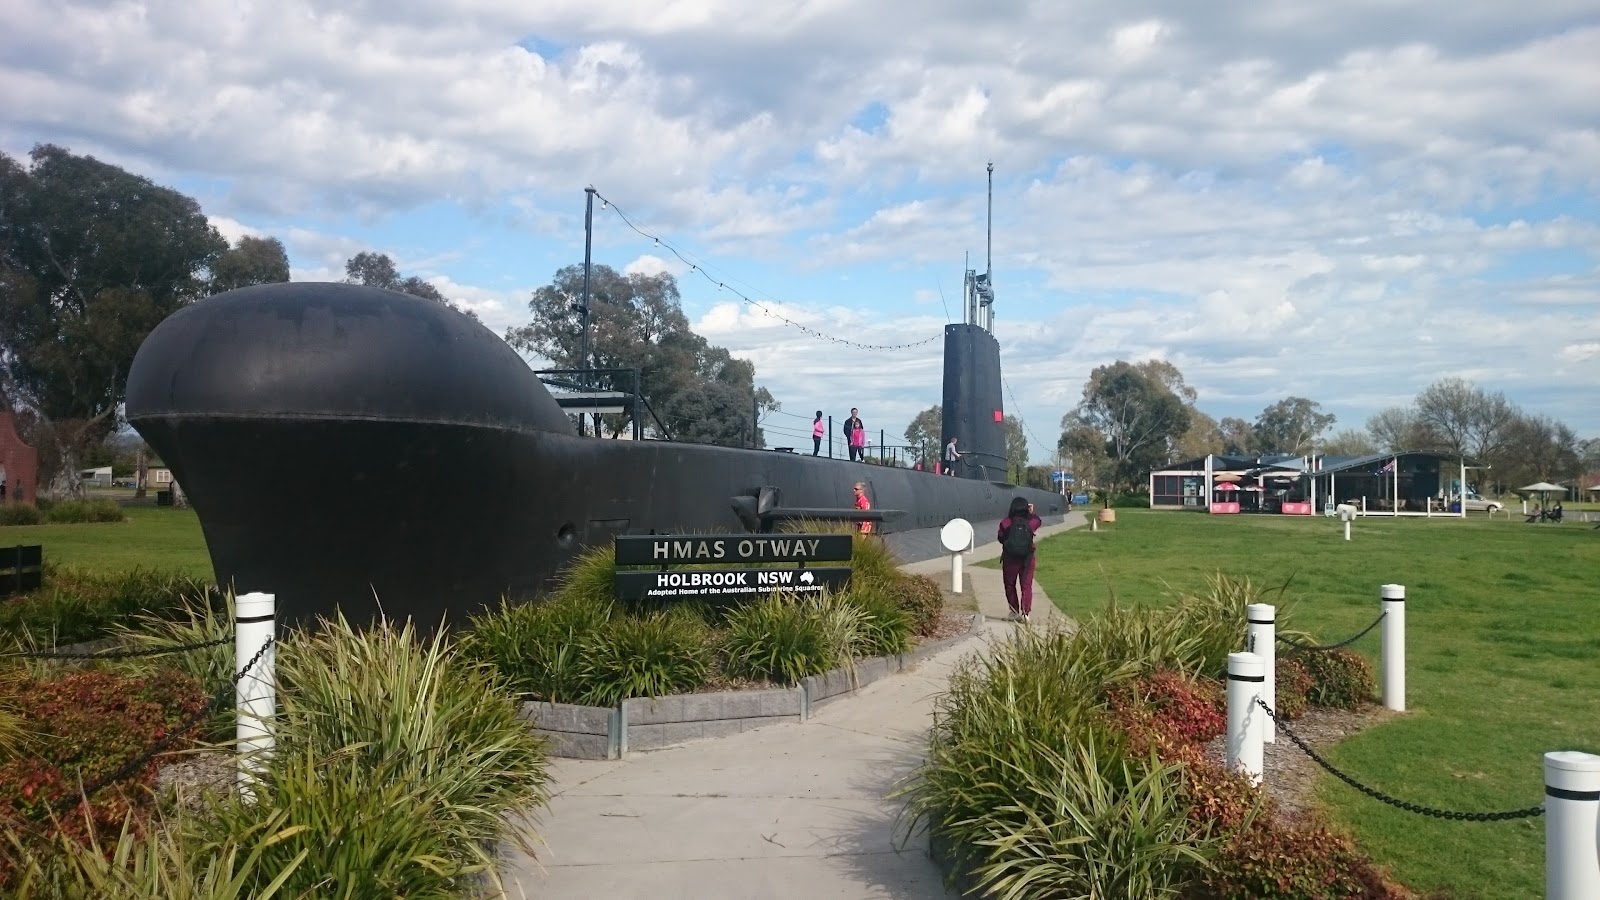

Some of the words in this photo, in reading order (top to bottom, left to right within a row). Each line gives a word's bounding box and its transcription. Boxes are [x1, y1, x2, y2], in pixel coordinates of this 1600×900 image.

[653, 541, 725, 558] HMAS
[738, 540, 820, 558] OTWAY
[657, 573, 747, 586] HOLBROOK
[758, 572, 793, 584] NSW
[648, 588, 677, 596] Adopted
